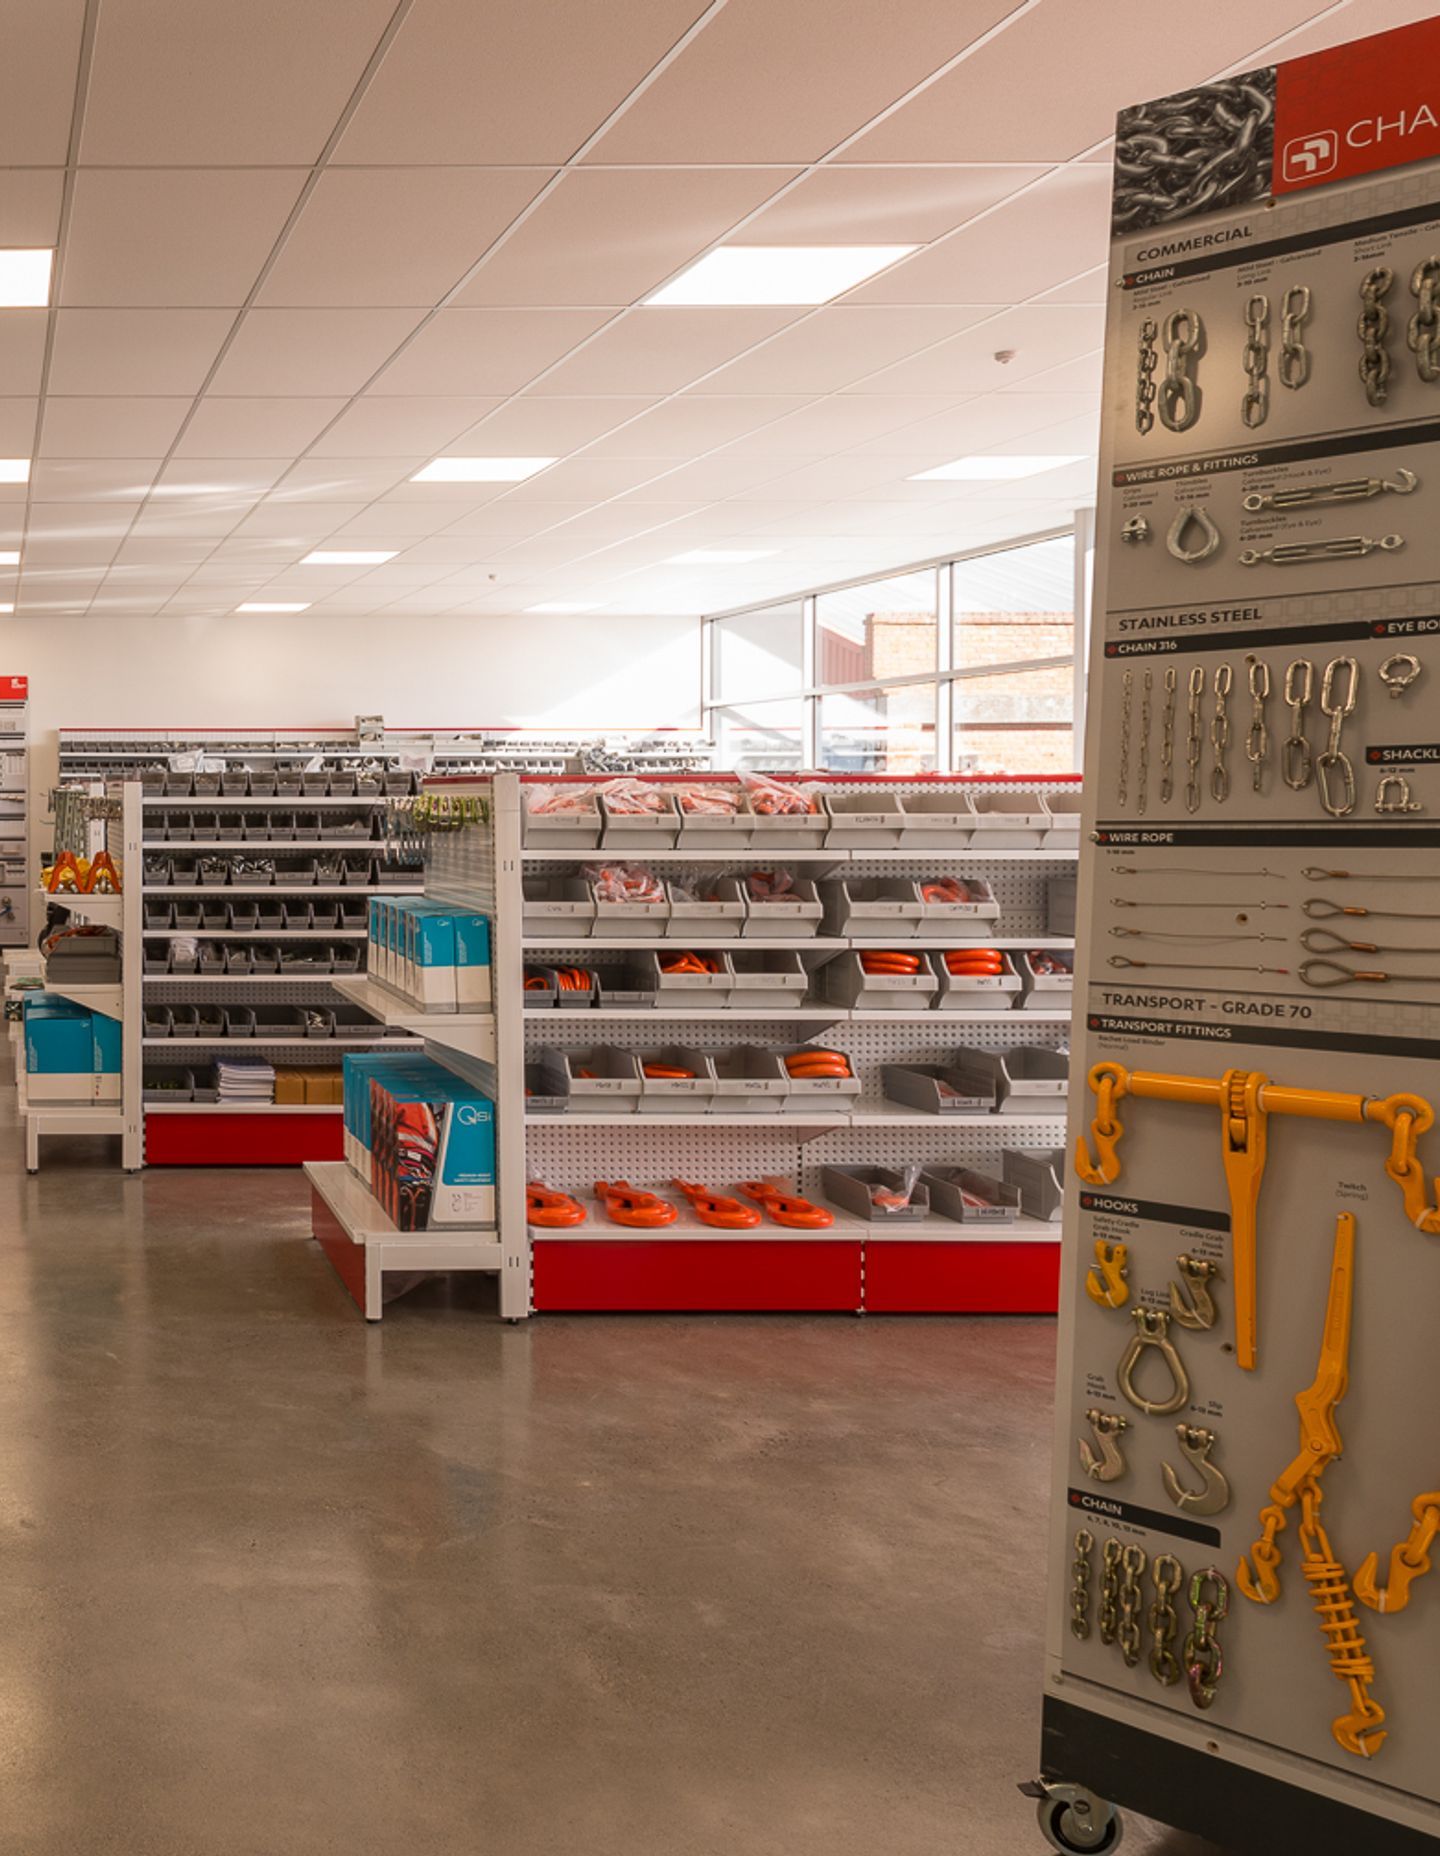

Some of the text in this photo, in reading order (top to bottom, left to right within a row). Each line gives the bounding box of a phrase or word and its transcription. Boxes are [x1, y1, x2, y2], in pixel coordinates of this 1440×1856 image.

[1346, 104, 1439, 148] CHA
[1136, 226, 1253, 262] COMMERCIAL
[1135, 267, 1175, 284] CHAIN
[1126, 454, 1259, 482] WIRE ROPE & FITTINGS
[1119, 608, 1263, 632] STAINLESS STEEL
[1388, 619, 1440, 633] EYE BO
[1118, 640, 1177, 654] CHAIN 316
[1383, 749, 1440, 760] SHACKL
[1109, 832, 1174, 843] WIRE ROPE
[1102, 993, 1206, 1011] TRANSPORT
[1222, 1001, 1285, 1017] GRADE
[1289, 1005, 1312, 1019] 70
[1101, 1018, 1232, 1039] TRANSPORT FITTINGS
[1093, 1198, 1138, 1214] HOOKS
[1081, 1496, 1122, 1515] CHAIN
